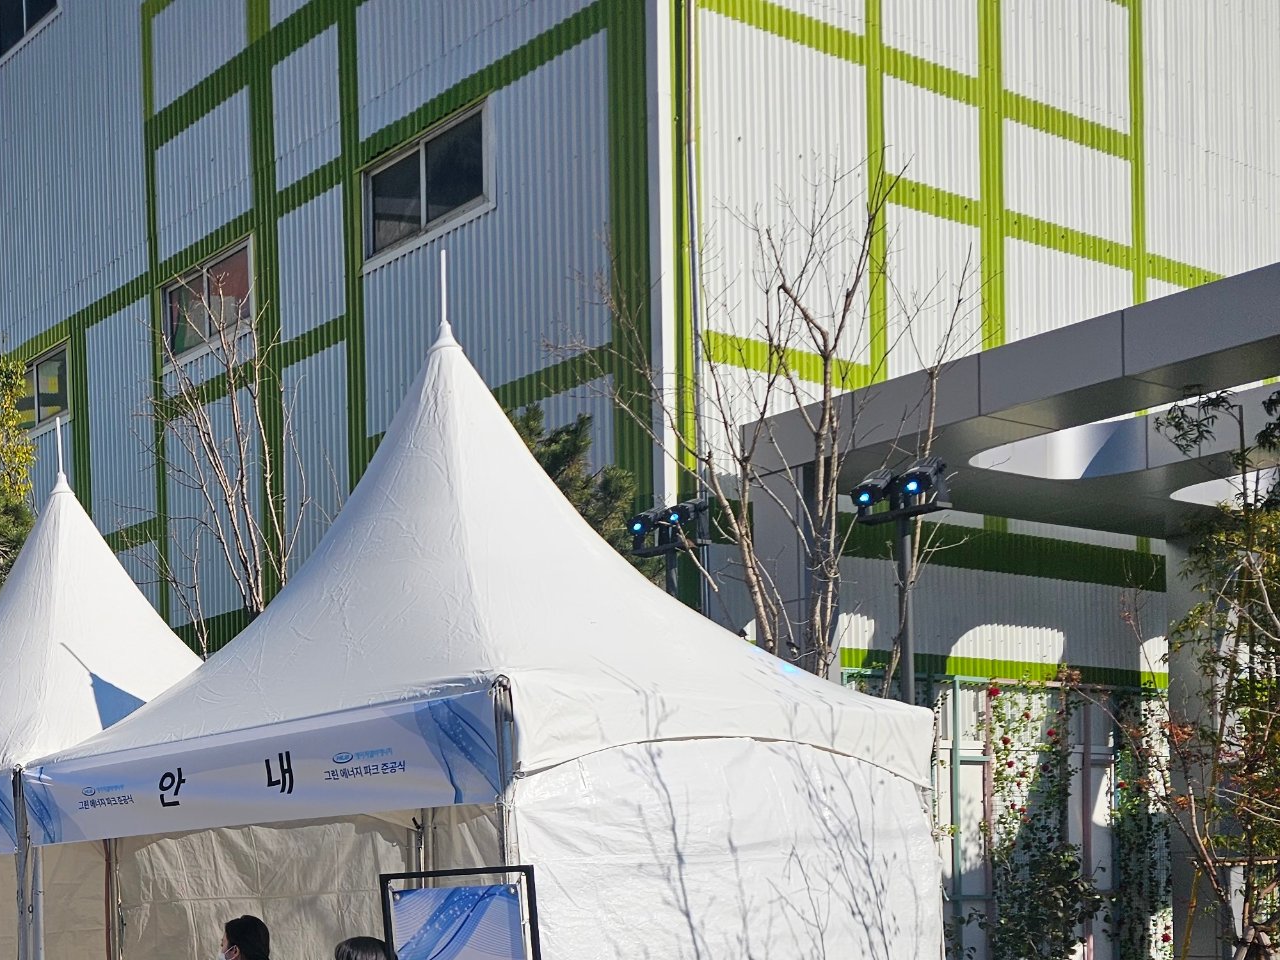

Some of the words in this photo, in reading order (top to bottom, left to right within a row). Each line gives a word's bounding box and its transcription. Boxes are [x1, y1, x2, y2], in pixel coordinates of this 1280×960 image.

[159, 767, 186, 807] 안
[265, 751, 294, 794] 내
[324, 769, 339, 780] 그린
[340, 766, 363, 779] 에너지
[364, 764, 380, 777] 파크
[380, 760, 406, 775] 준공식
[78, 800, 90, 810] 그린
[106, 796, 118, 807] 파크
[117, 794, 135, 805] 준공식
